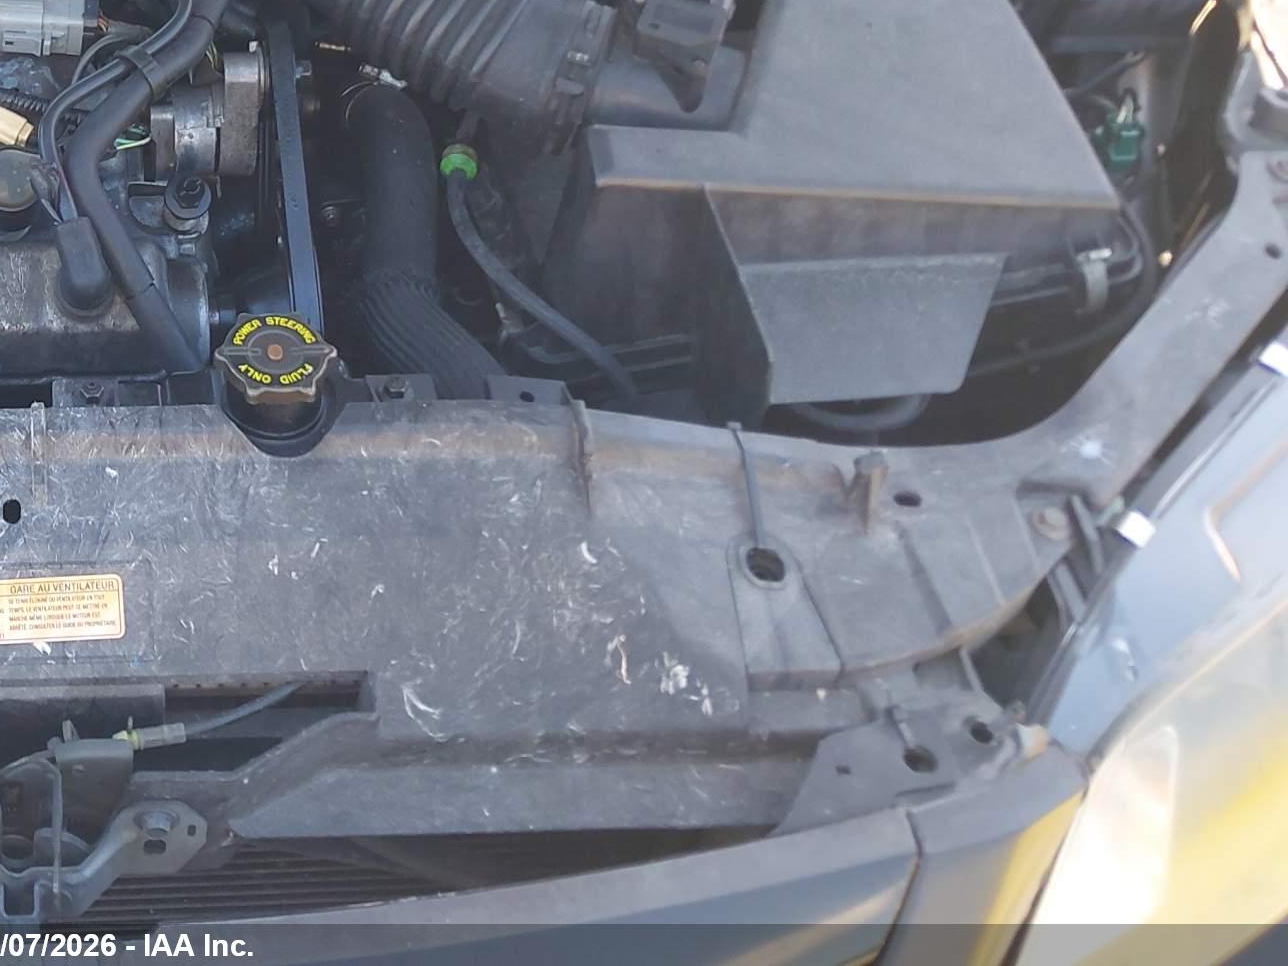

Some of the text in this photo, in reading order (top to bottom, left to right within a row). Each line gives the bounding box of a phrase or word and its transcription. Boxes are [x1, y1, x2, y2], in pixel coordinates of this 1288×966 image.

[233, 316, 316, 346] POWER STEERING
[238, 363, 314, 385] FLUID ONLY
[10, 581, 114, 594] GARE AU VENTILATEUR
